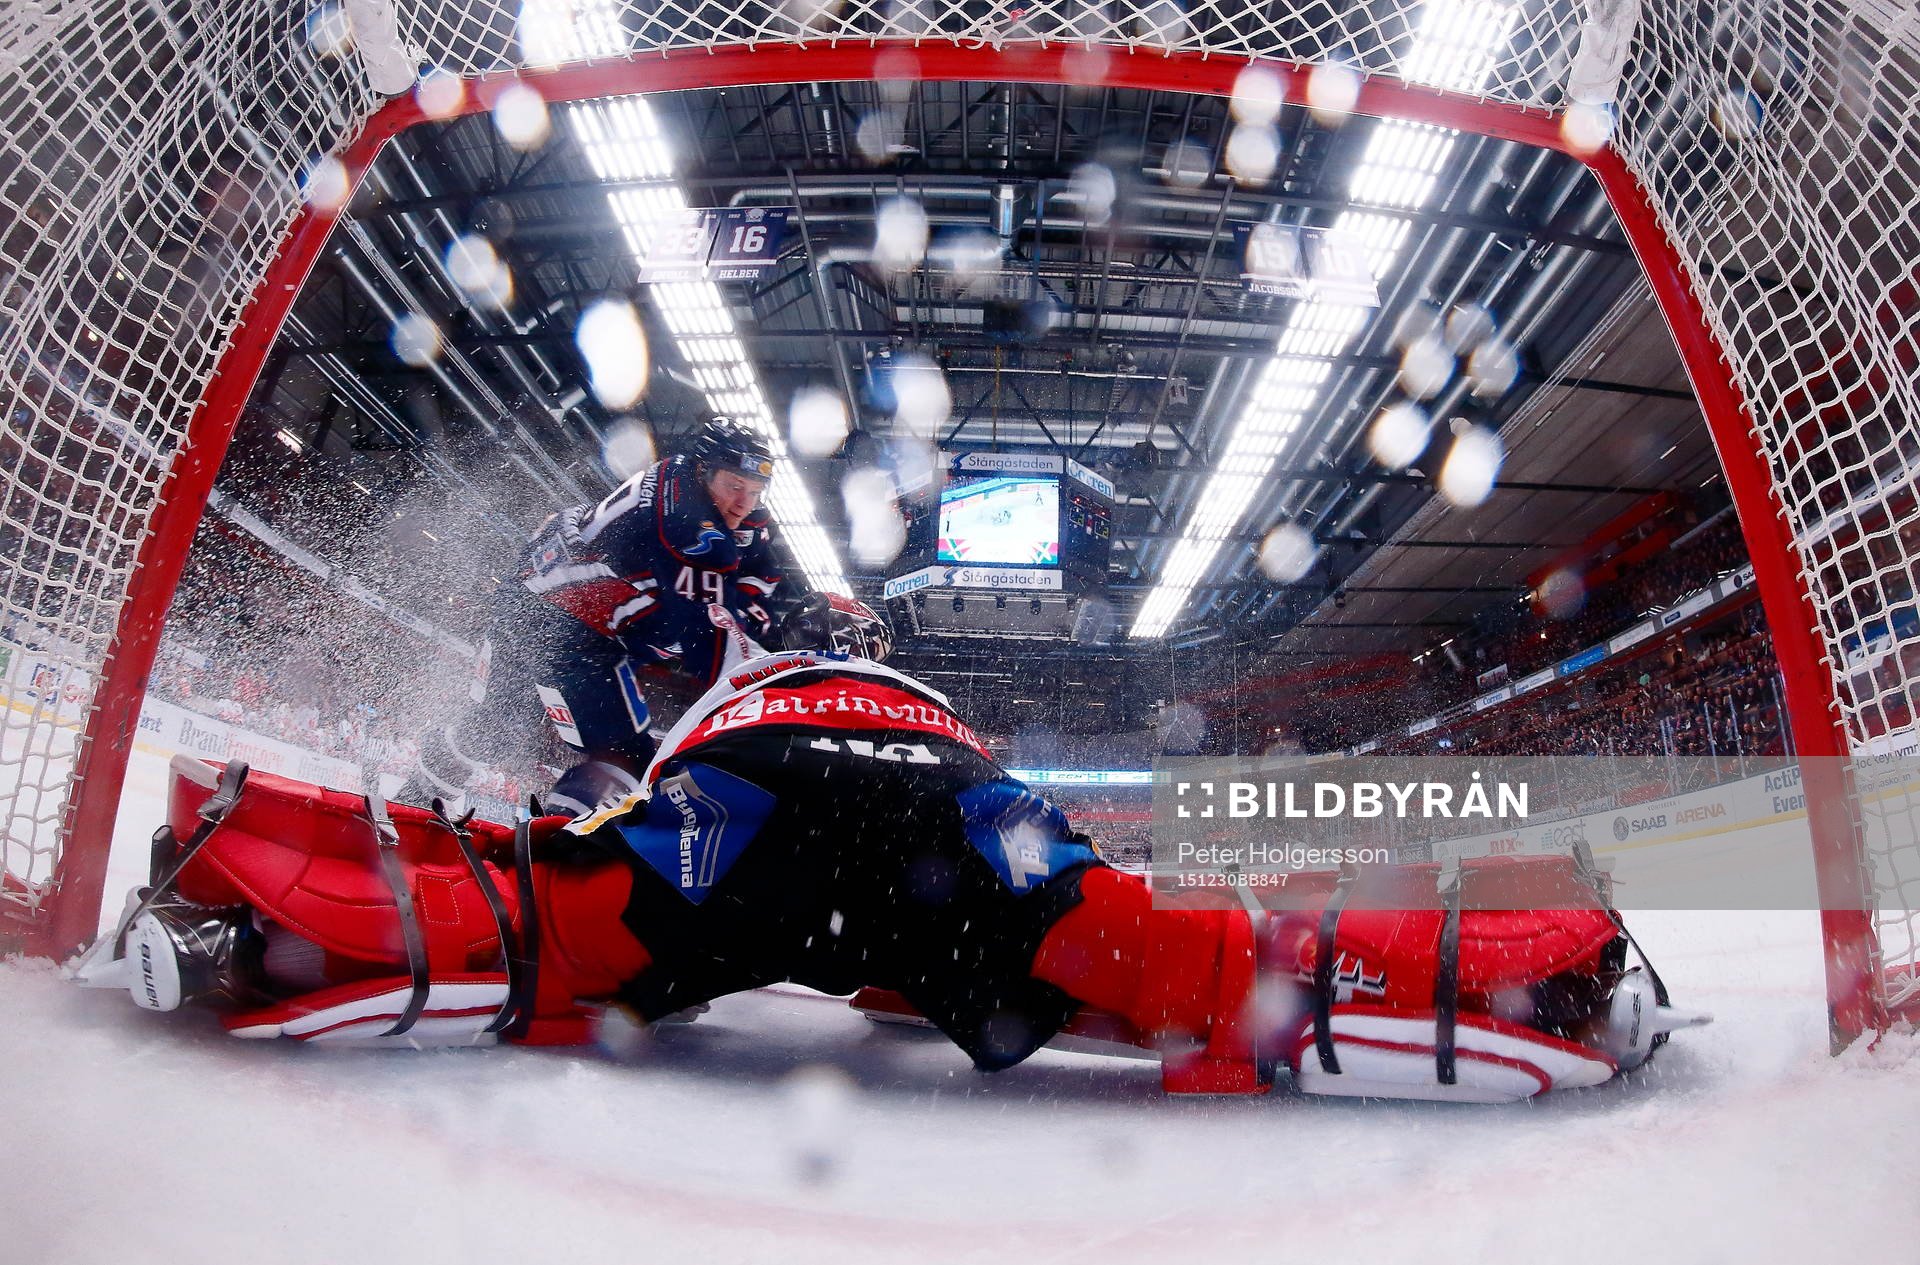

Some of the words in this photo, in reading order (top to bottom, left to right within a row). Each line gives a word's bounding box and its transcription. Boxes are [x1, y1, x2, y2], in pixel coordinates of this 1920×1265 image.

[729, 226, 767, 254] 16
[719, 269, 760, 279] HELBER
[968, 455, 1054, 470] Stångåstaden
[1069, 461, 1113, 498] Corren
[675, 566, 723, 606] 49
[886, 572, 930, 597] Corren
[962, 570, 1051, 587] Stångåstaden
[1631, 814, 1668, 833] SAAB
[1675, 803, 1727, 826] ARENA
[141, 942, 160, 1008] BAUER
